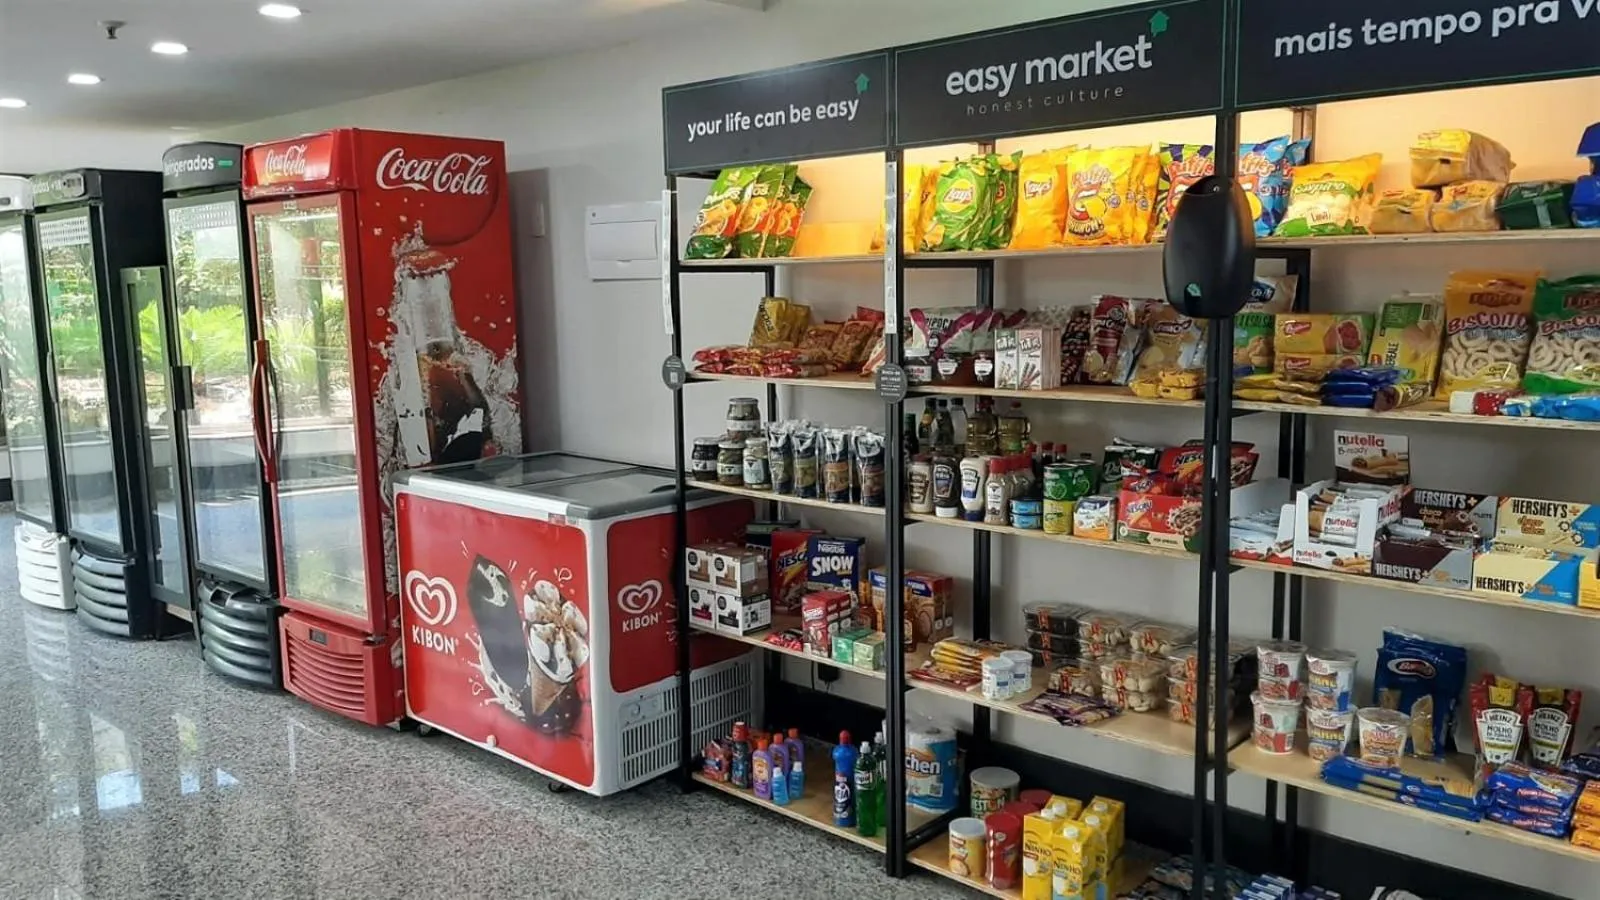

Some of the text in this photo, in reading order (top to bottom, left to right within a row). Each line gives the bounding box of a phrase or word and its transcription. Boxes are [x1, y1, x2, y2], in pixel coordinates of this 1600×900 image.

[1274, 0, 1600, 58] mais tempo pra v
[945, 34, 1152, 98] easy market
[967, 85, 1124, 116] honest culture
[687, 98, 859, 142] your life can be easy
[265, 143, 308, 177] Coca-Cola
[376, 148, 493, 195] Coca-Cola
[1338, 434, 1385, 448] nutella
[1414, 490, 1467, 508] HERSHEY'S
[1512, 499, 1568, 518] HERSHEY'S
[1325, 517, 1358, 528] nutella
[811, 555, 854, 577] SNOW
[1376, 563, 1421, 580] HERSHEY'S
[1475, 576, 1525, 594] HERSHEY'S
[622, 614, 660, 632] KIBON
[412, 624, 456, 655] KIBON
[1489, 712, 1513, 723] HEINZ
[1025, 843, 1052, 857] NINHO
[1053, 861, 1082, 876] NINHO
